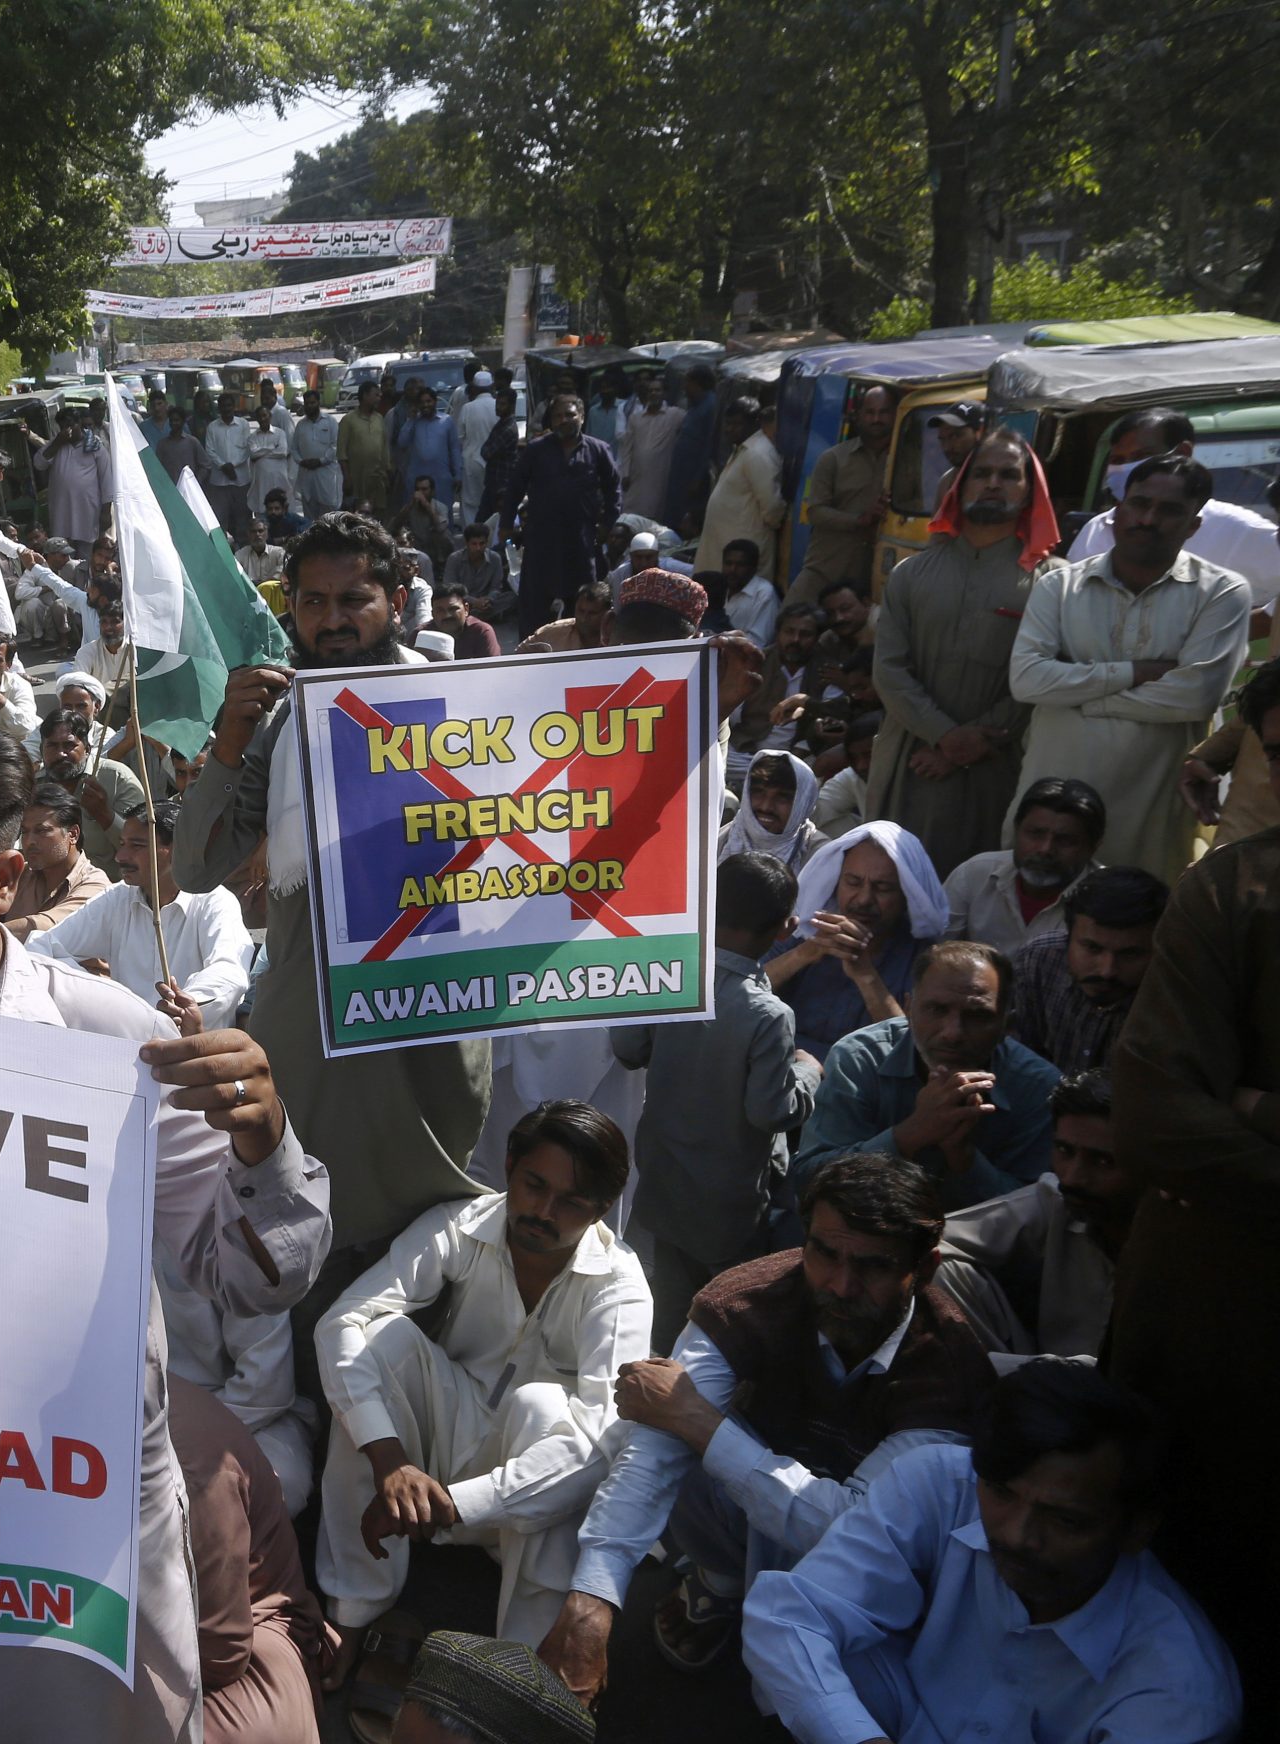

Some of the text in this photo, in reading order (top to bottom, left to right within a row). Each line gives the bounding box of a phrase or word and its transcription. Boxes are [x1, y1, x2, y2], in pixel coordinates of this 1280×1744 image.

[177, 231, 249, 261] ریلی
[344, 231, 369, 247] سیاہ
[427, 219, 446, 235] 27
[365, 704, 665, 774] KICK OUT
[403, 788, 612, 844] FRENCH
[398, 860, 625, 909] AMBASSDOR
[342, 960, 683, 1027] AWAMI PASBAN
